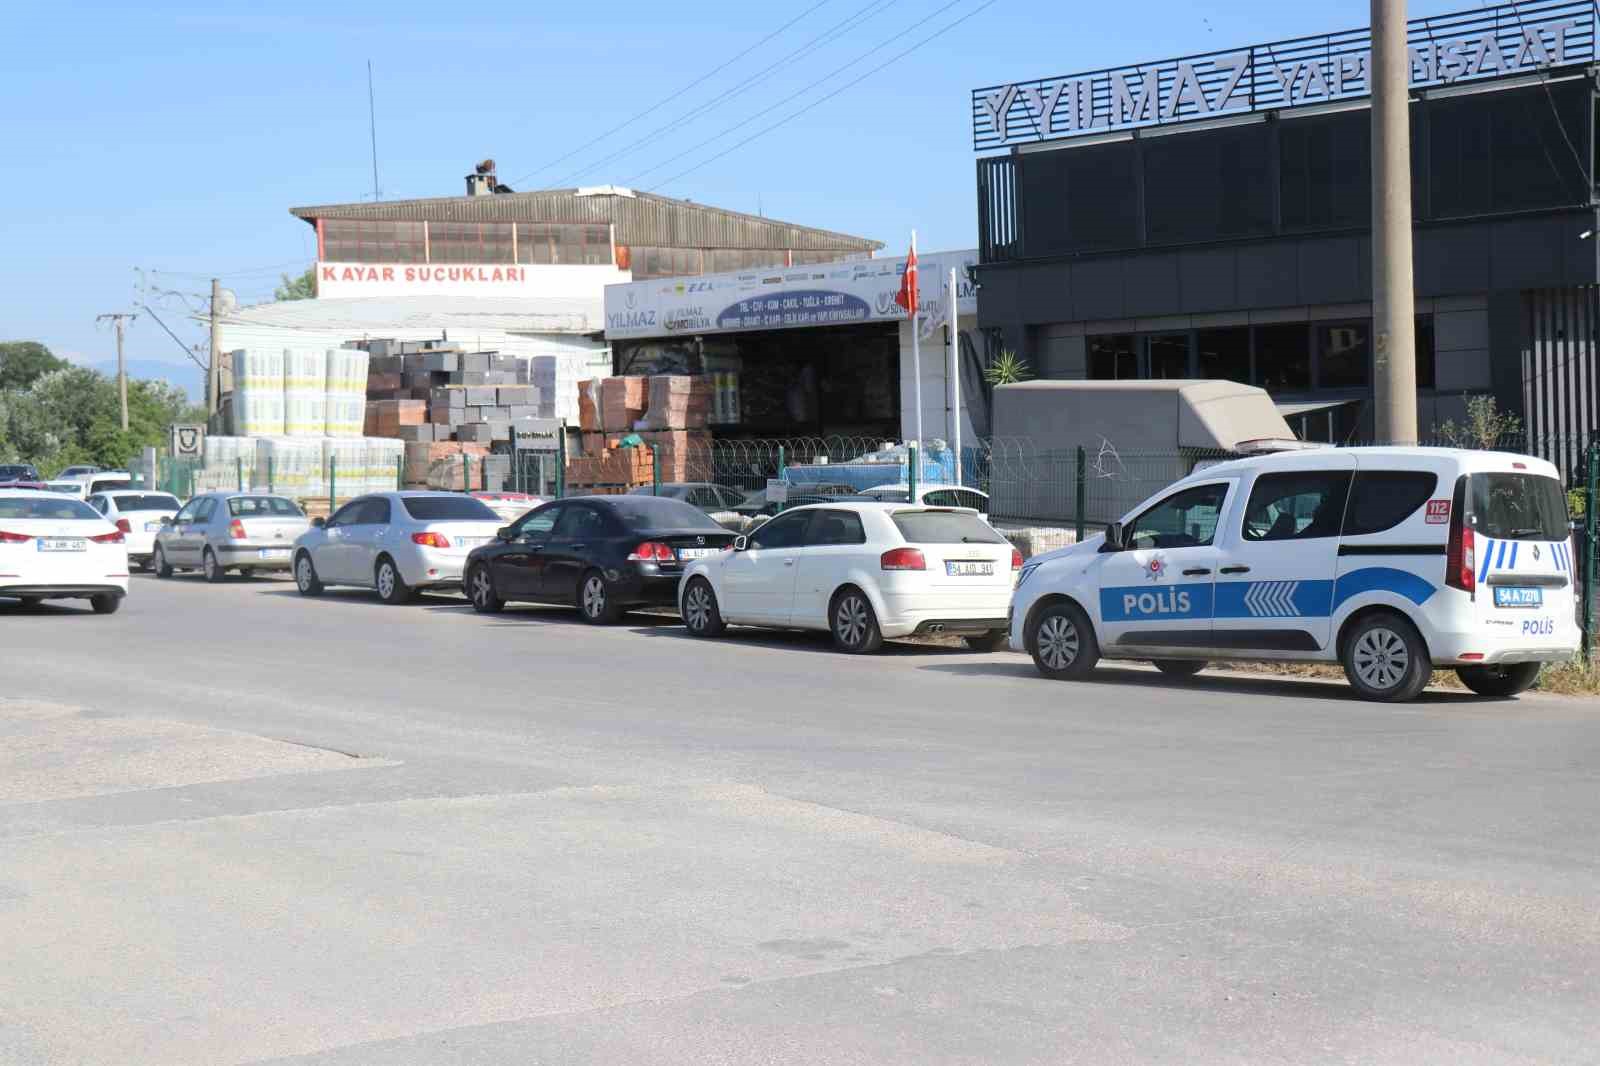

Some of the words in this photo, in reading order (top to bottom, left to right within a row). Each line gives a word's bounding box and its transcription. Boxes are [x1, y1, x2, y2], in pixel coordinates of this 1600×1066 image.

[1025, 54, 1252, 135] YILMAZ
[1272, 53, 1371, 103] YAPI
[1407, 20, 1577, 86] NŞAAT
[322, 266, 395, 282] KAYAR
[404, 266, 526, 282] SUCUKLARI
[1430, 502, 1448, 514] 112
[1123, 586, 1191, 615] POLİS
[1500, 590, 1512, 602] 54
[1522, 616, 1554, 635] POLİS
